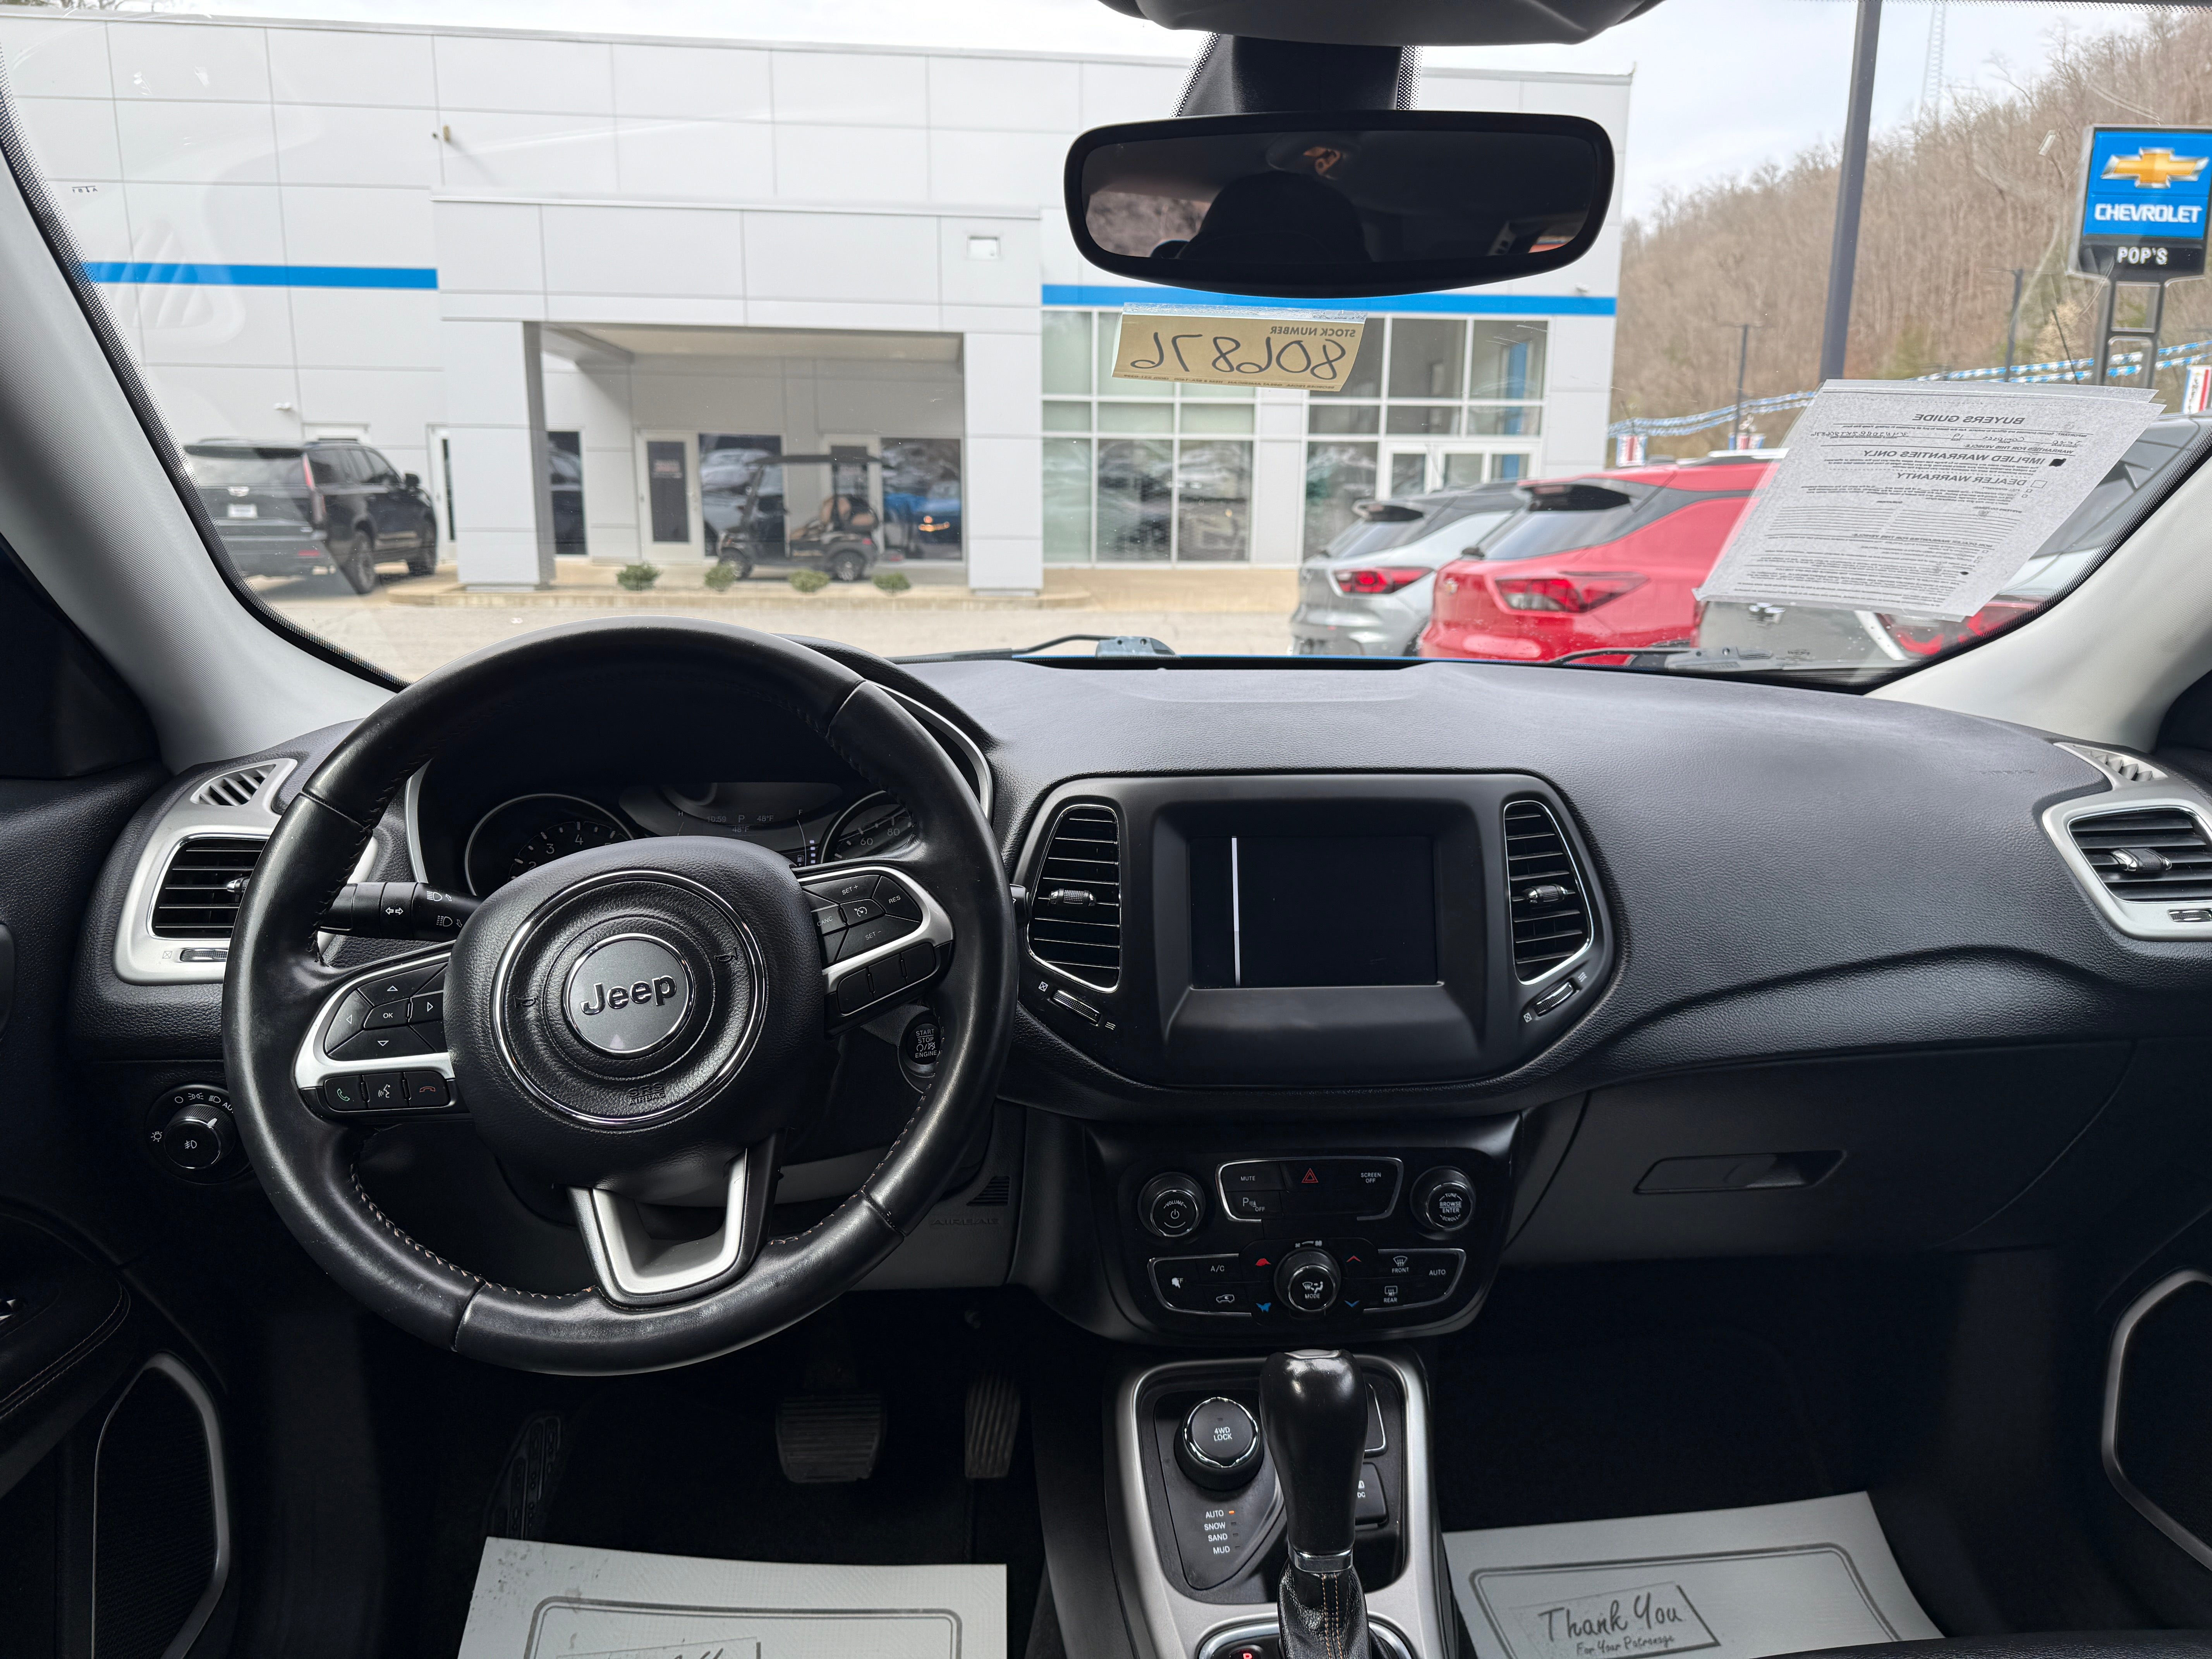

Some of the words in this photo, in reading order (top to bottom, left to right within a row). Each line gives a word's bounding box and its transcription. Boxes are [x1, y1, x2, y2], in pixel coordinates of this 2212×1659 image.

[2095, 203, 2203, 223] CHEVROLET
[2117, 247, 2168, 265] POP'S
[575, 834, 584, 845] 4
[546, 843, 555, 854] 3
[842, 886, 852, 895] SET
[888, 895, 901, 904] RES
[817, 916, 833, 927] CANC
[865, 931, 876, 940] SET
[580, 975, 677, 1016] Jeep
[915, 1050, 937, 1058] ENGINE
[627, 1082, 665, 1097] SRS
[629, 1092, 665, 1106] AIRBAG
[222, 1102, 234, 1113] AU
[1213, 1433, 1233, 1441] LOCK
[1206, 1510, 1224, 1518] AUTO
[1204, 1522, 1226, 1531] SNOW
[1208, 1533, 1228, 1542] SAND
[1213, 1546, 1230, 1555] MUD
[1537, 1600, 1628, 1642] Thank
[1633, 1592, 1683, 1629] You
[1577, 1642, 1595, 1655] For
[1597, 1638, 1622, 1653] Your
